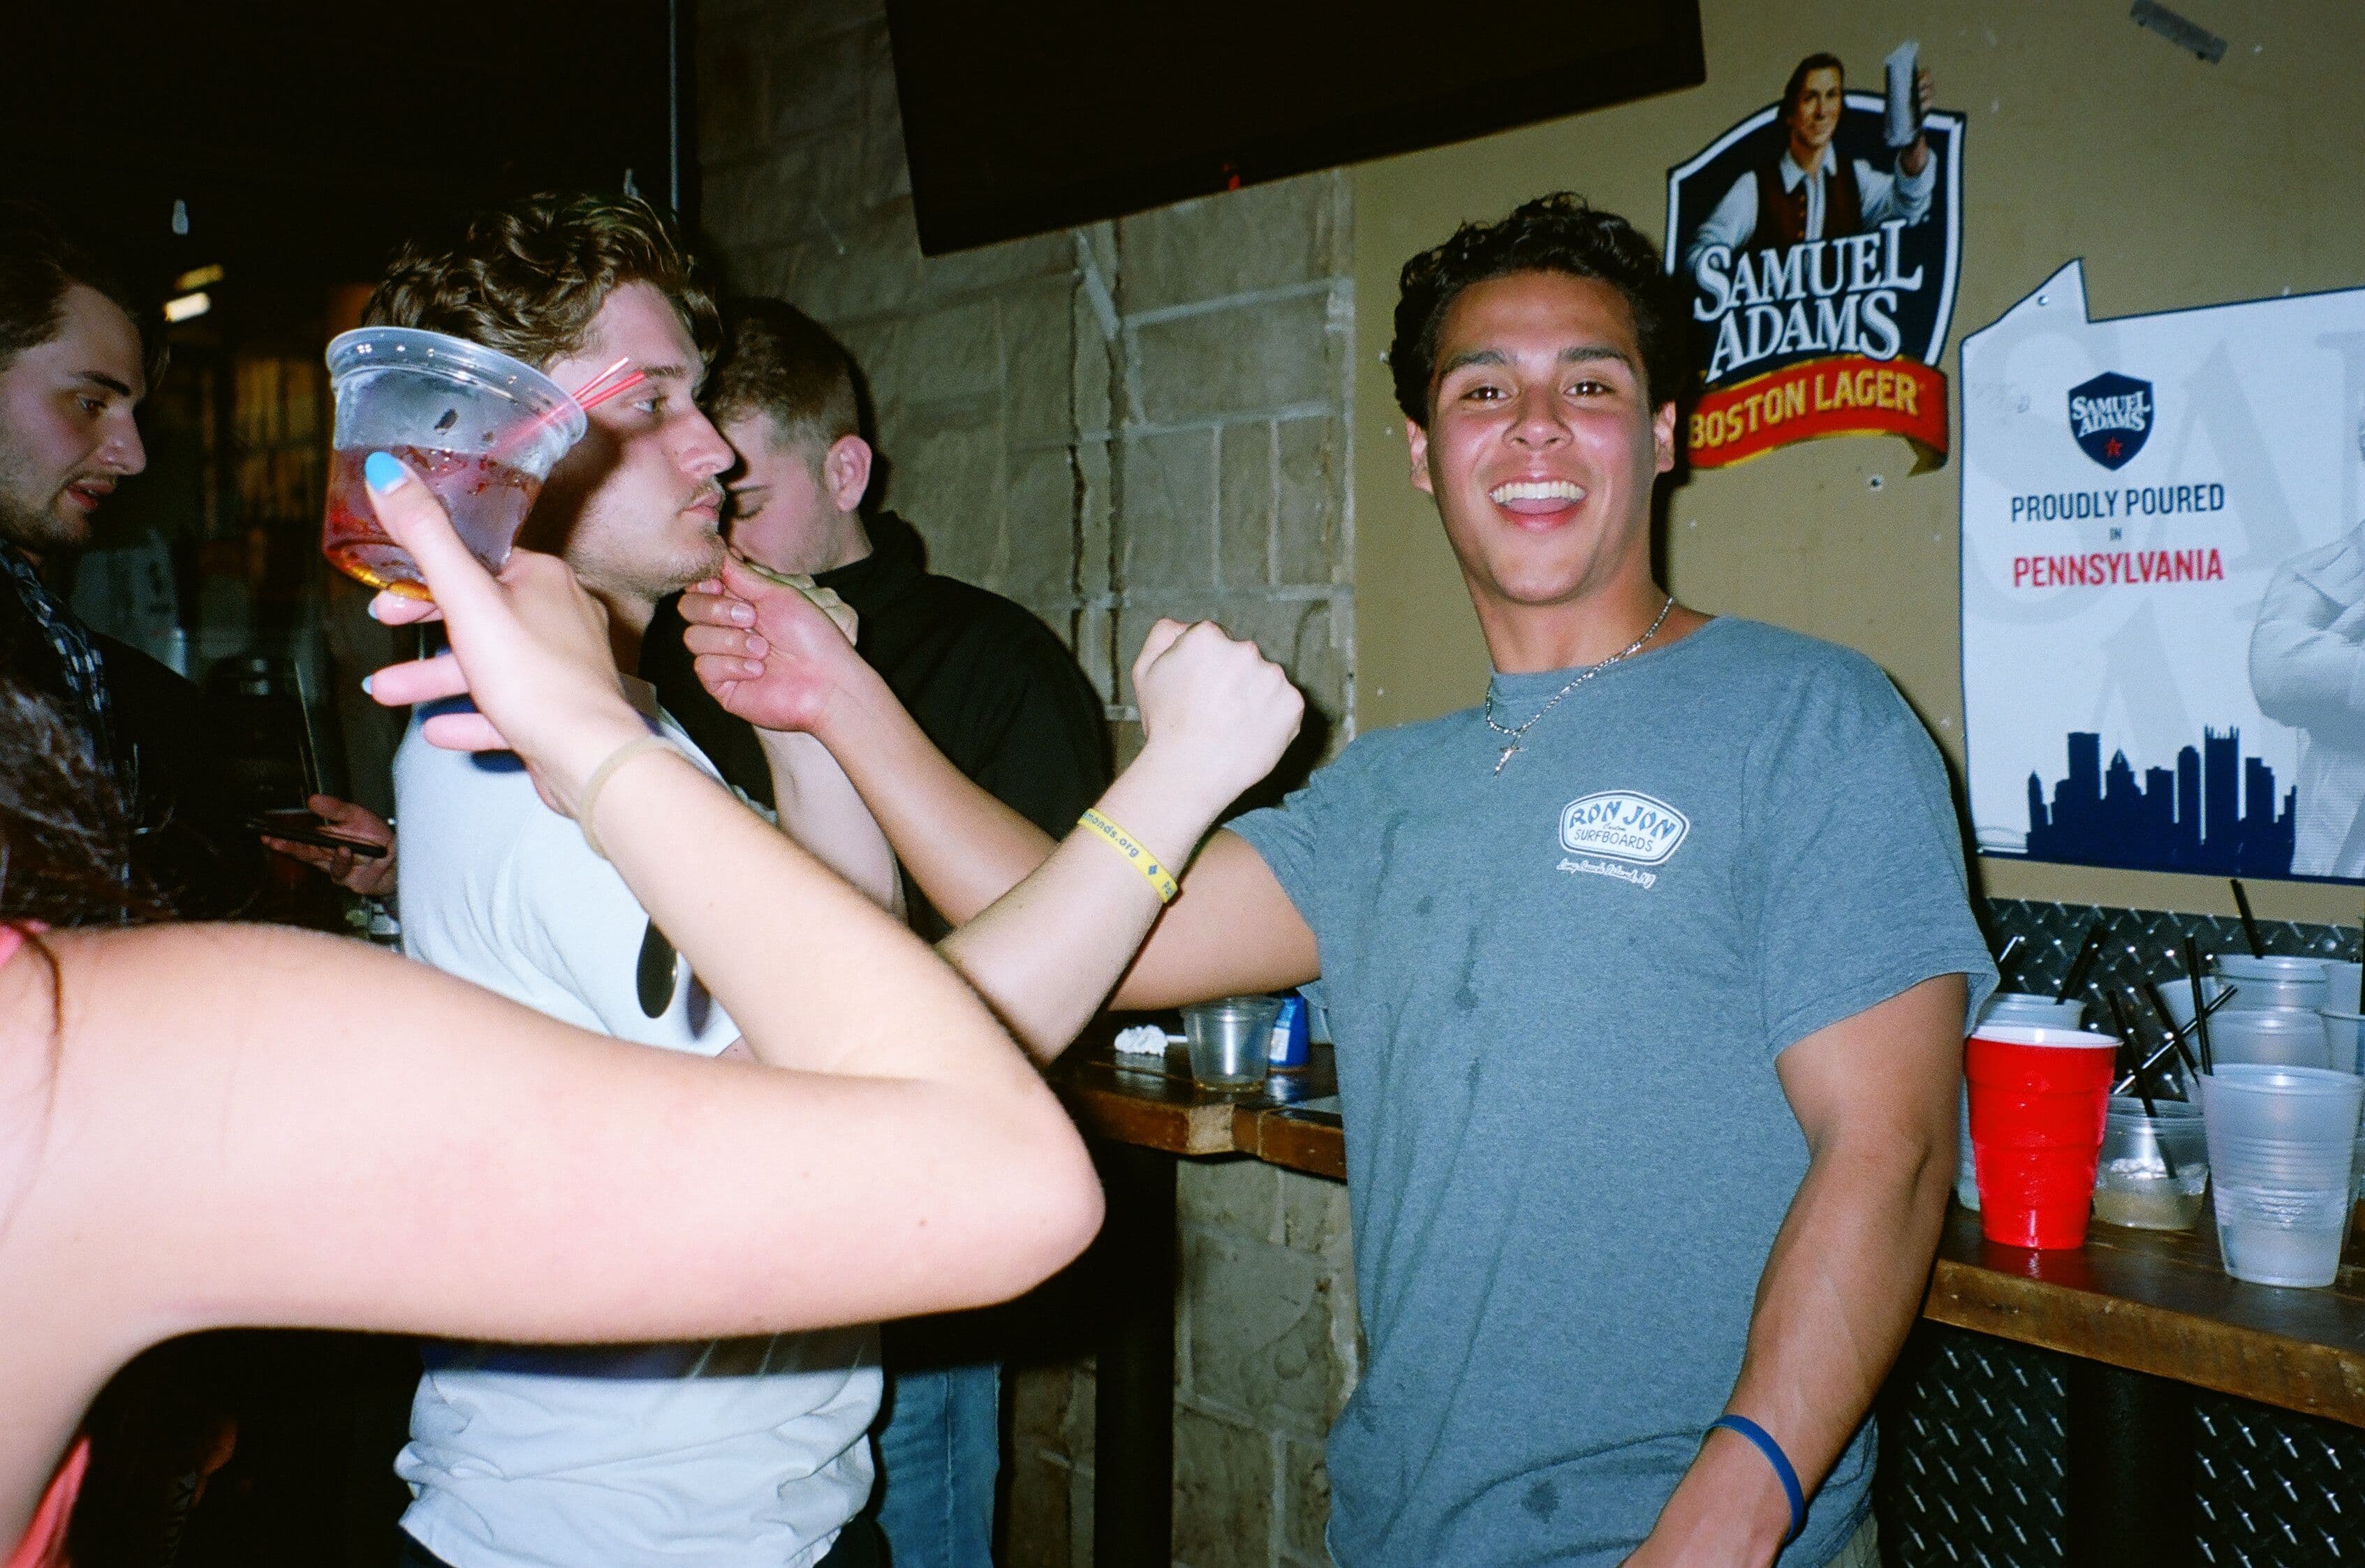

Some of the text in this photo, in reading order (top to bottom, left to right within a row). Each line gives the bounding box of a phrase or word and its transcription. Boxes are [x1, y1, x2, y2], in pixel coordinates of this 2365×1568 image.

[1693, 219, 1923, 322] SAMUEL
[1705, 290, 1901, 384] ADAMS
[1688, 369, 1919, 450] BOSTON LAGER
[2072, 391, 2151, 420] SAMUEL
[2078, 412, 2146, 438] ADAMS
[2012, 483, 2225, 522] PROUDLY POURED
[2014, 548, 2224, 588] PENNSYLVANIA
[1570, 800, 1677, 840] RON JON
[1574, 829, 1654, 852] SURFBOARDS
